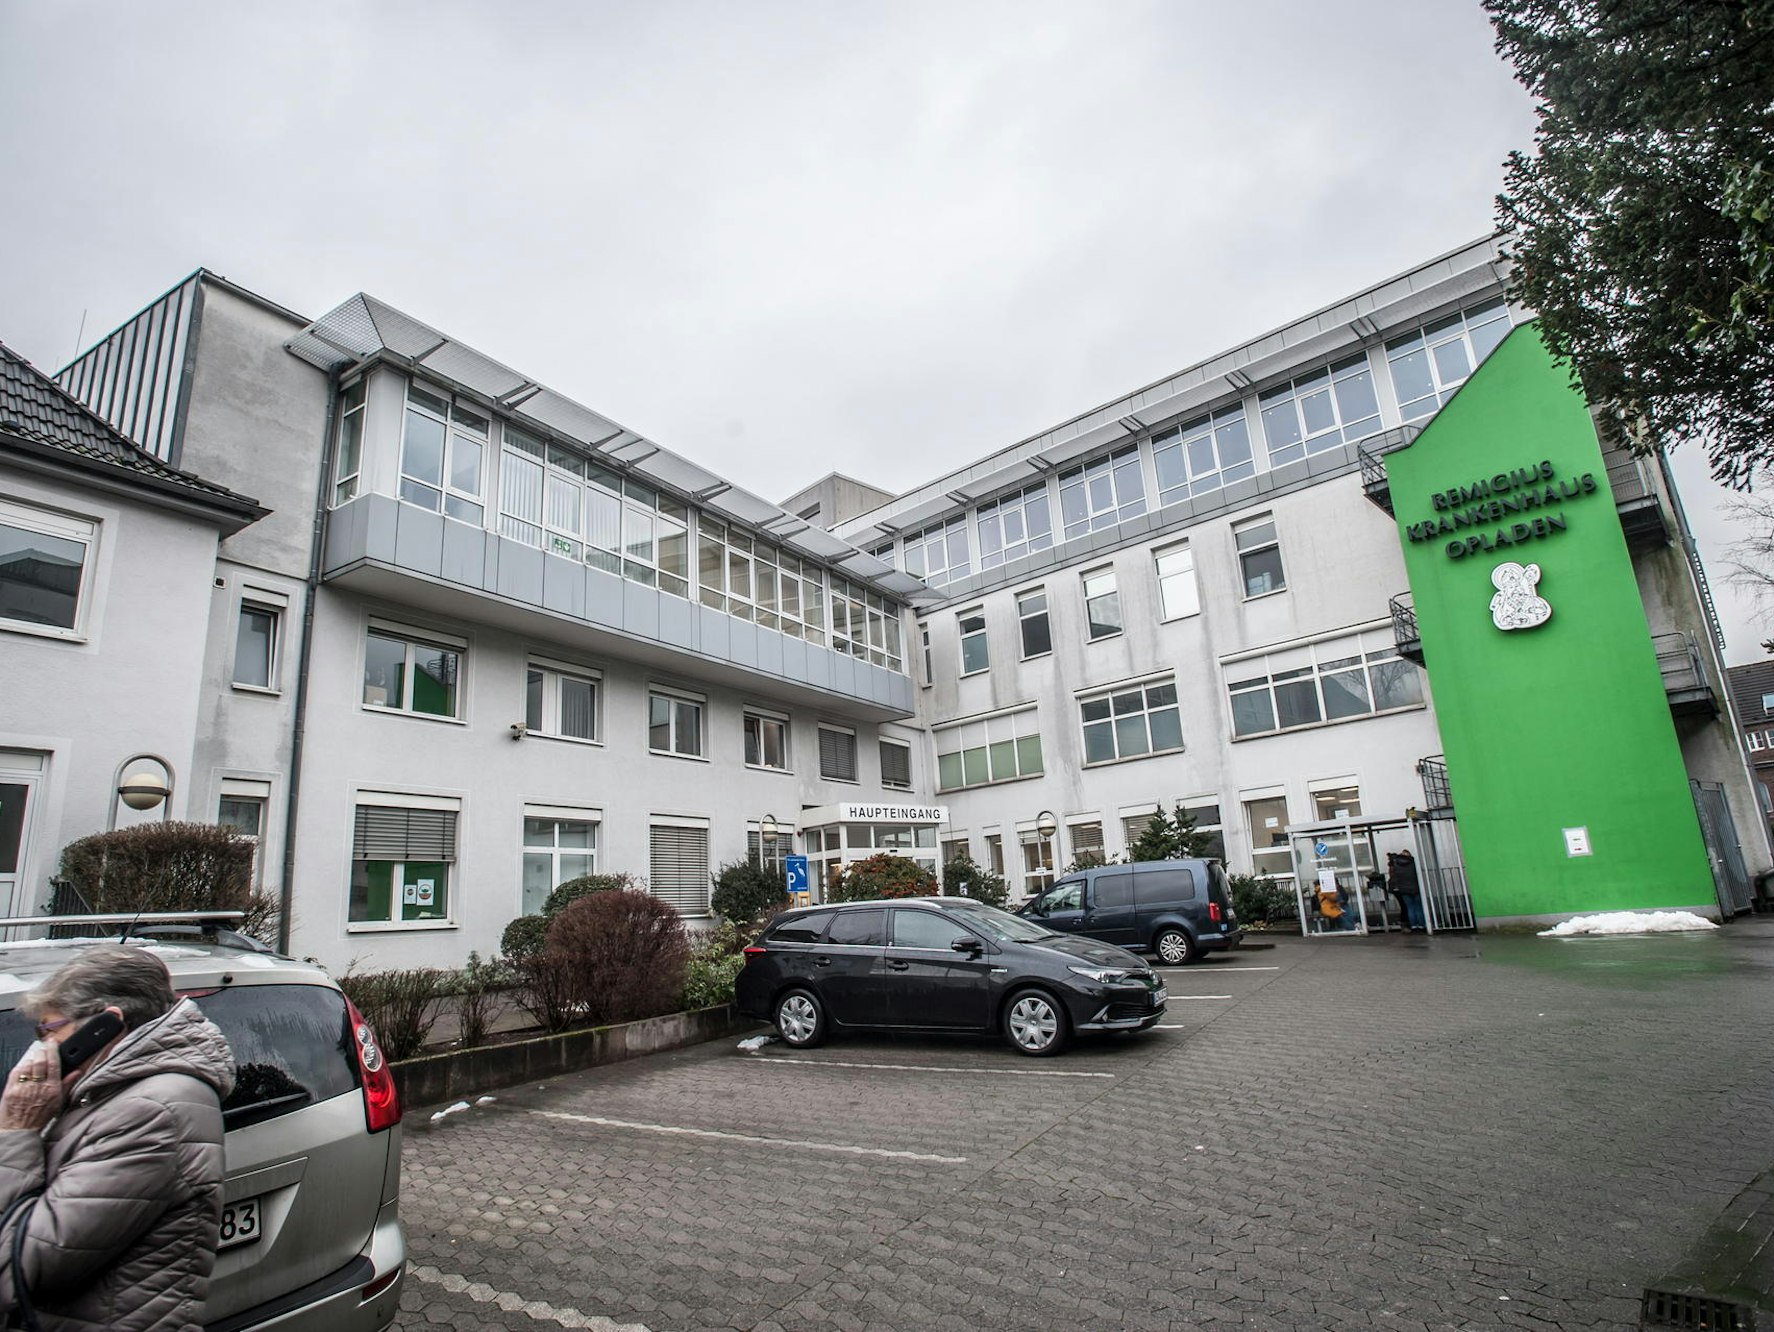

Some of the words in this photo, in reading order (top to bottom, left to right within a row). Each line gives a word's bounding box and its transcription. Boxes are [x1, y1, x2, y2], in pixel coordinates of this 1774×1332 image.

[1431, 459, 1554, 511] REMIGIUS
[1406, 473, 1597, 542] KRANKENHAUS
[1445, 512, 1568, 559] OPLADEN
[849, 806, 941, 819] HAUPTEINGANG
[788, 871, 796, 890] P
[219, 1203, 256, 1240] 83
